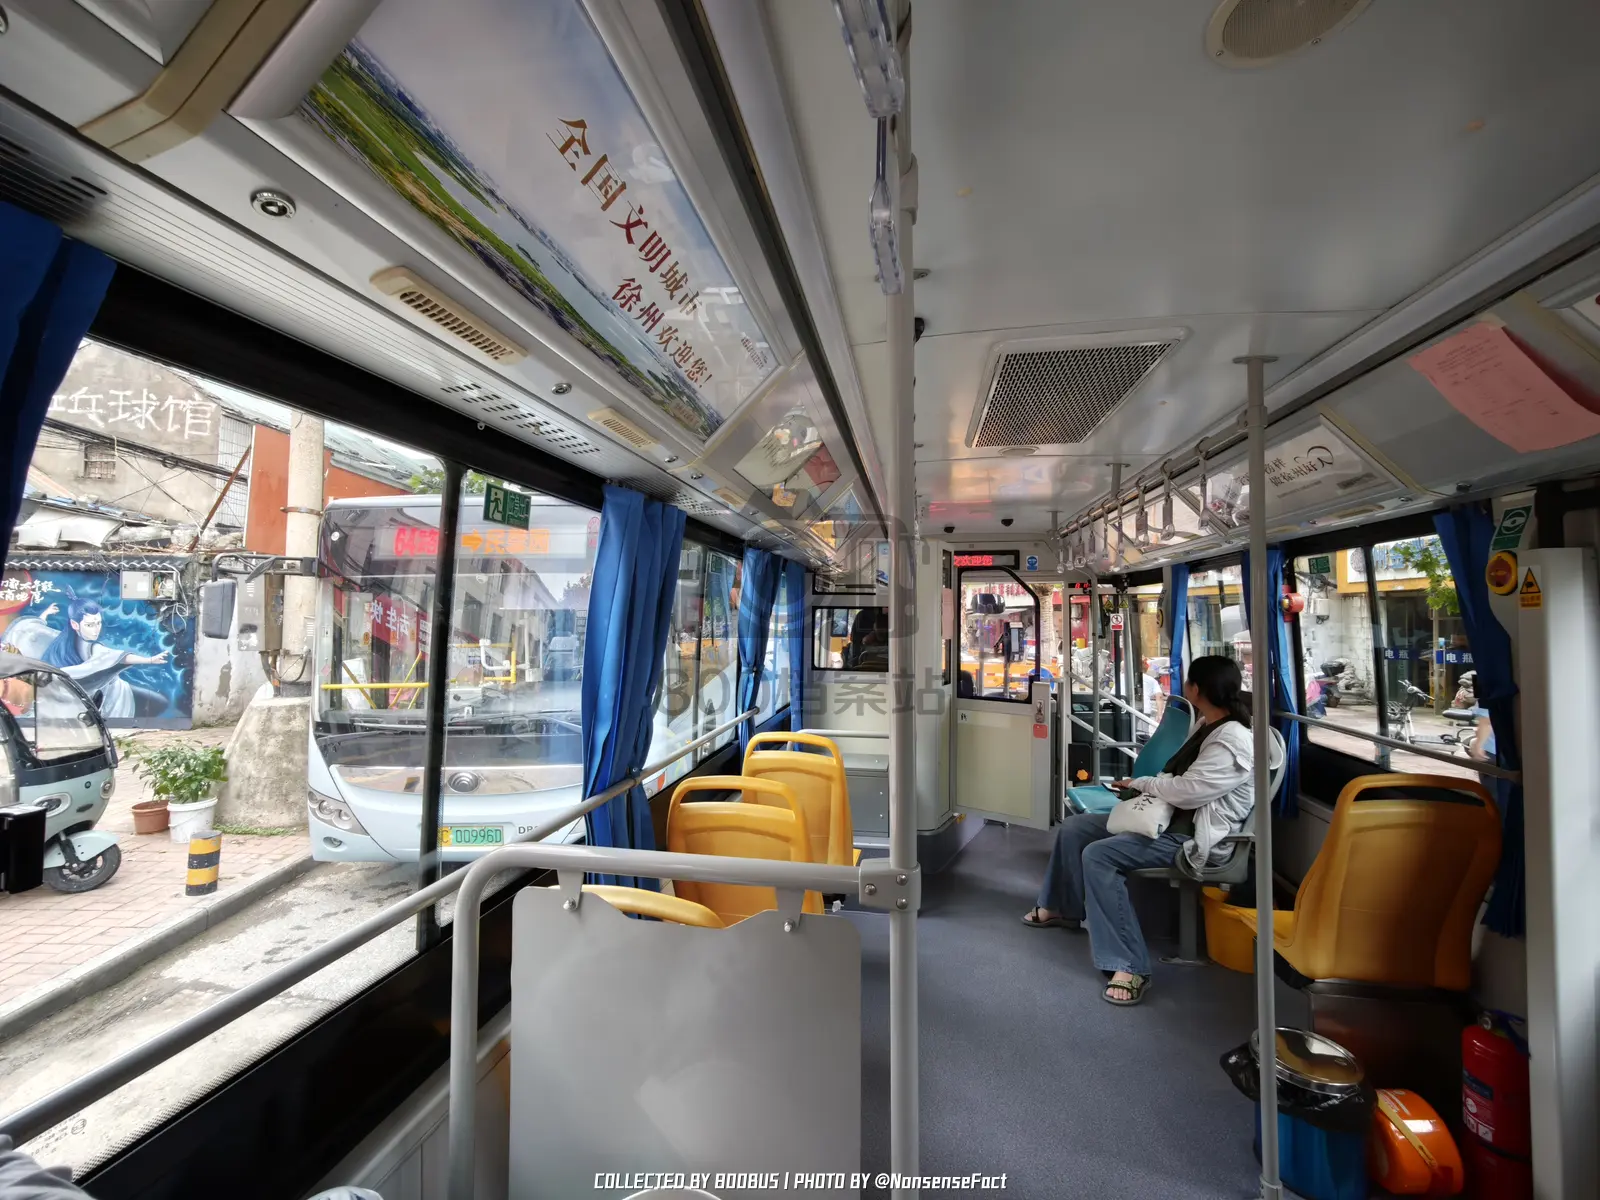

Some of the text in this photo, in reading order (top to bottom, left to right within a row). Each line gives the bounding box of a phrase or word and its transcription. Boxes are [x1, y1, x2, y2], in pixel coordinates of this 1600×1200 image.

[546, 117, 702, 315] 全国文明城市
[440, 829, 502, 844] C00996D
